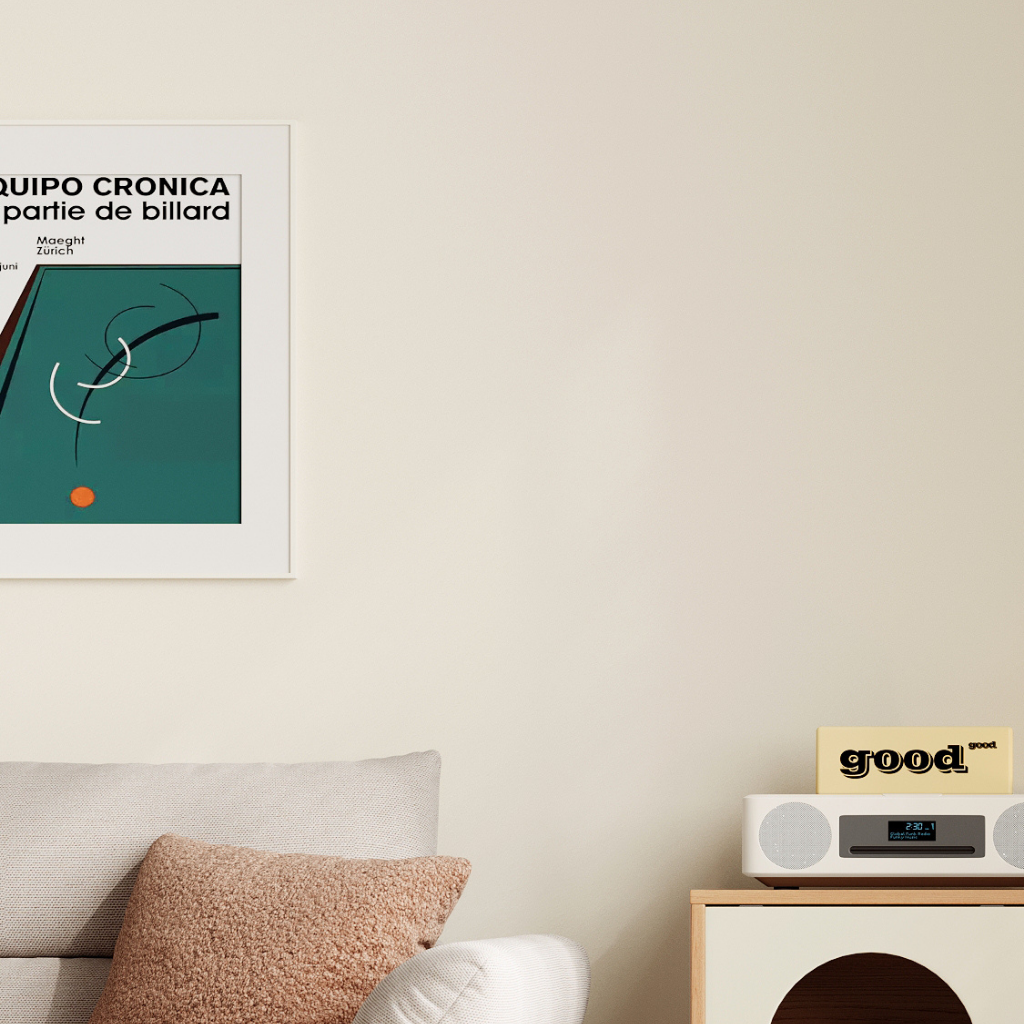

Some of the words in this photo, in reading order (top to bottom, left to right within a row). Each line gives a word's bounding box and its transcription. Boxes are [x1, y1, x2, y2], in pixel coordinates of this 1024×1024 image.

[93, 177, 230, 196] CRONICA
[4, 201, 85, 224] partie
[95, 201, 132, 220] de
[143, 201, 230, 220] billard
[36, 236, 85, 249] Maeght
[36, 245, 74, 255] Zürich
[968, 740, 998, 751] good
[839, 744, 969, 779] good
